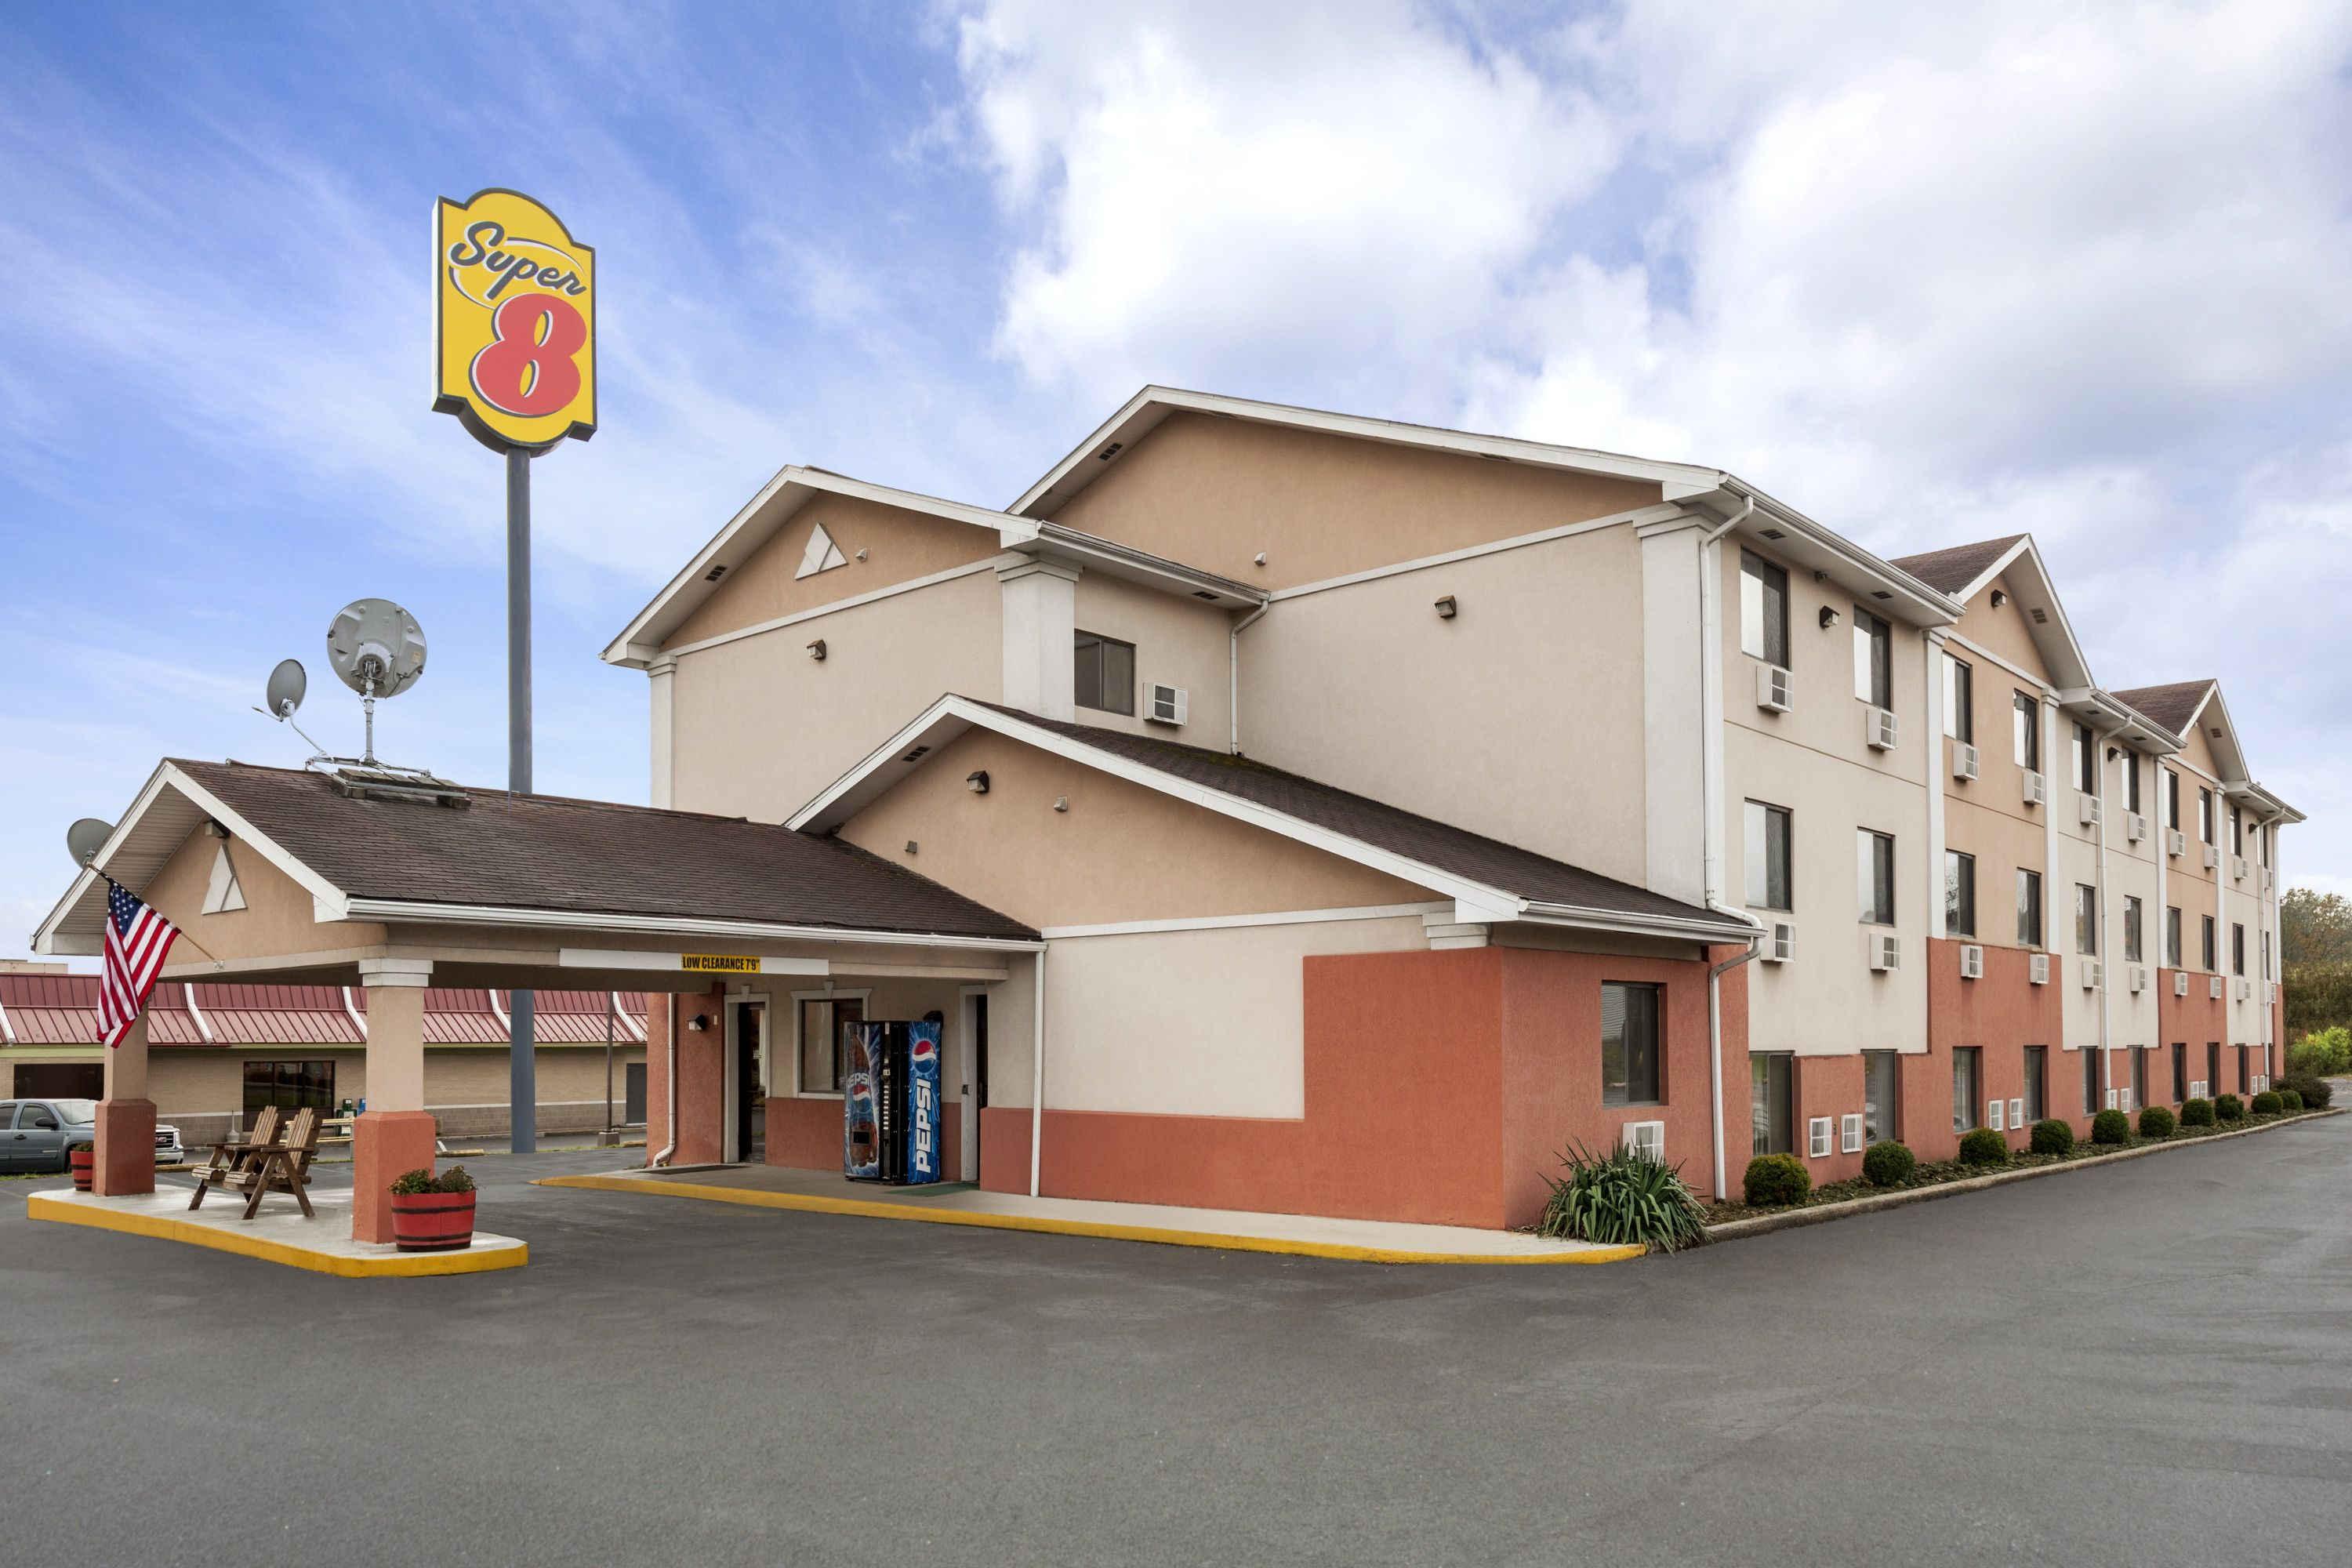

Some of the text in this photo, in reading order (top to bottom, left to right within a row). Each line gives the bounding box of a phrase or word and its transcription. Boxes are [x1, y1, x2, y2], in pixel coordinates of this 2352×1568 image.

[448, 220, 587, 301] Super
[469, 293, 587, 418] 8
[683, 956, 700, 968] LOW
[702, 957, 744, 970] CLEARANCE
[916, 1078, 932, 1174] PEPSI
